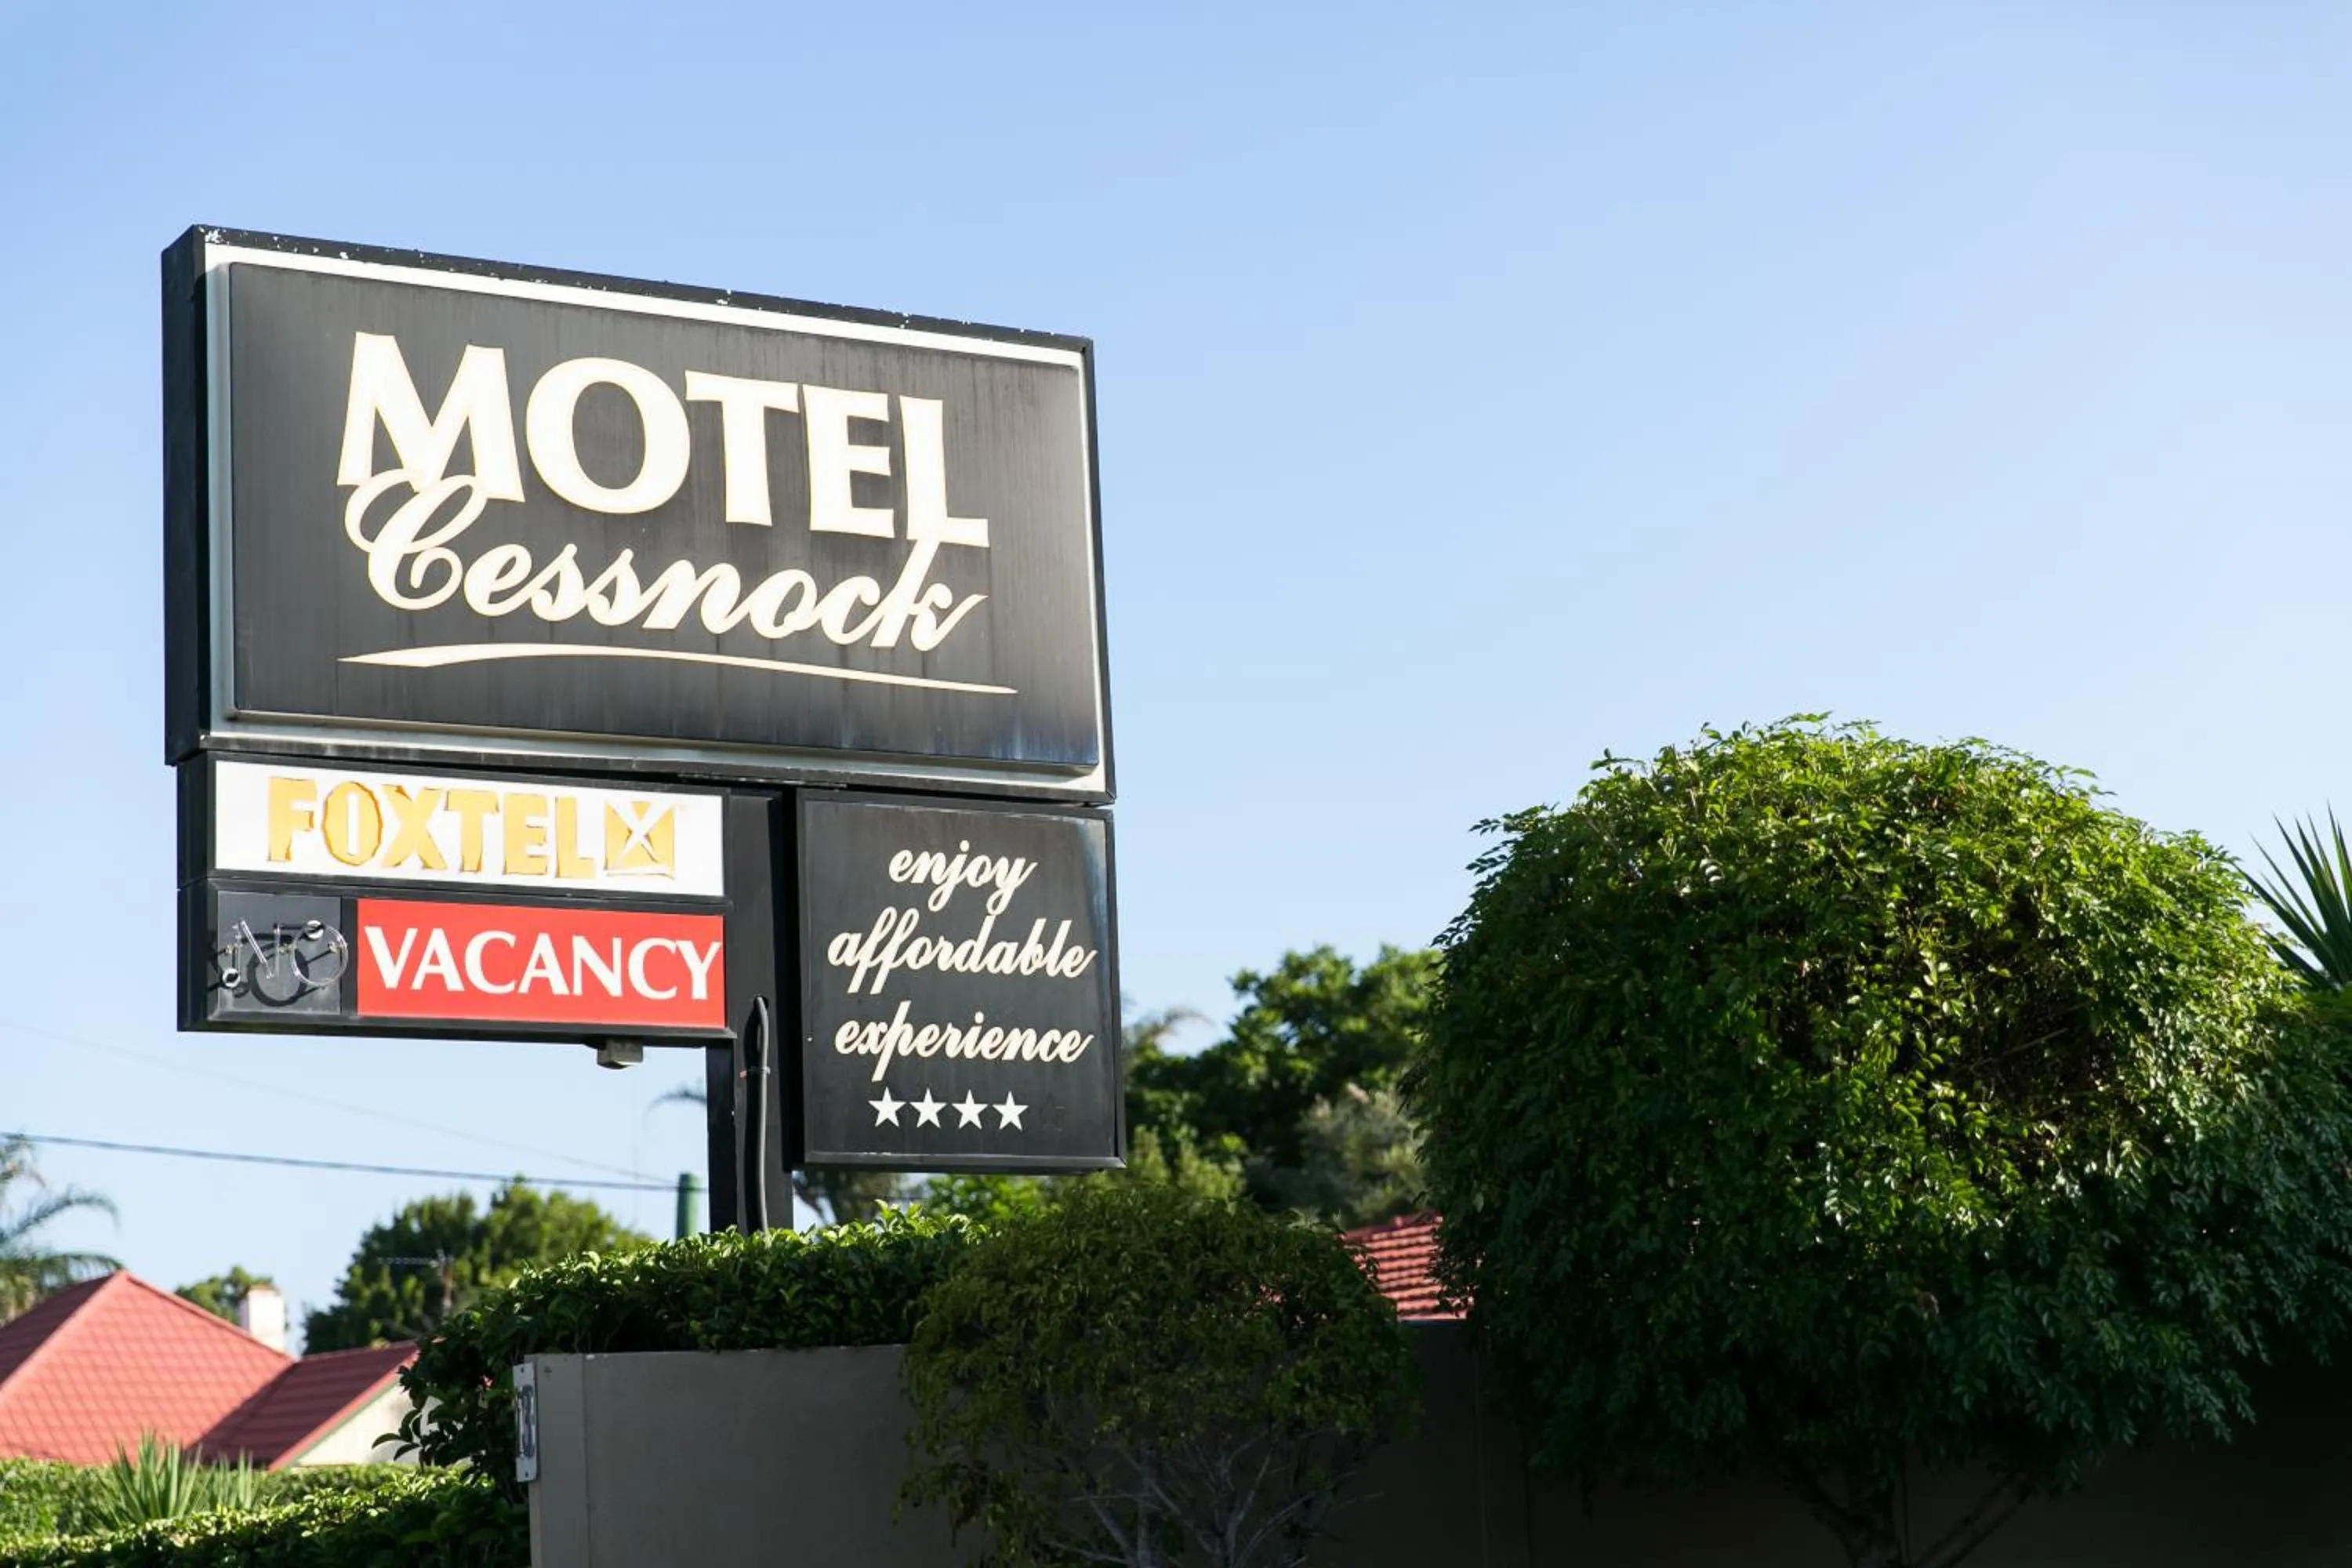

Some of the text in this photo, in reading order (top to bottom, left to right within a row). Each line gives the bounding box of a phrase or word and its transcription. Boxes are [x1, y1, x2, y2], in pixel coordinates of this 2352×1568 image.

[337, 331, 989, 548] MOTEL
[343, 468, 989, 652] Cessnock
[267, 775, 597, 880] FOXTEL
[888, 840, 1038, 915] enjoy
[365, 925, 722, 1000] VACANCY
[827, 906, 1098, 995] affordable
[835, 1000, 1094, 1082] experience
